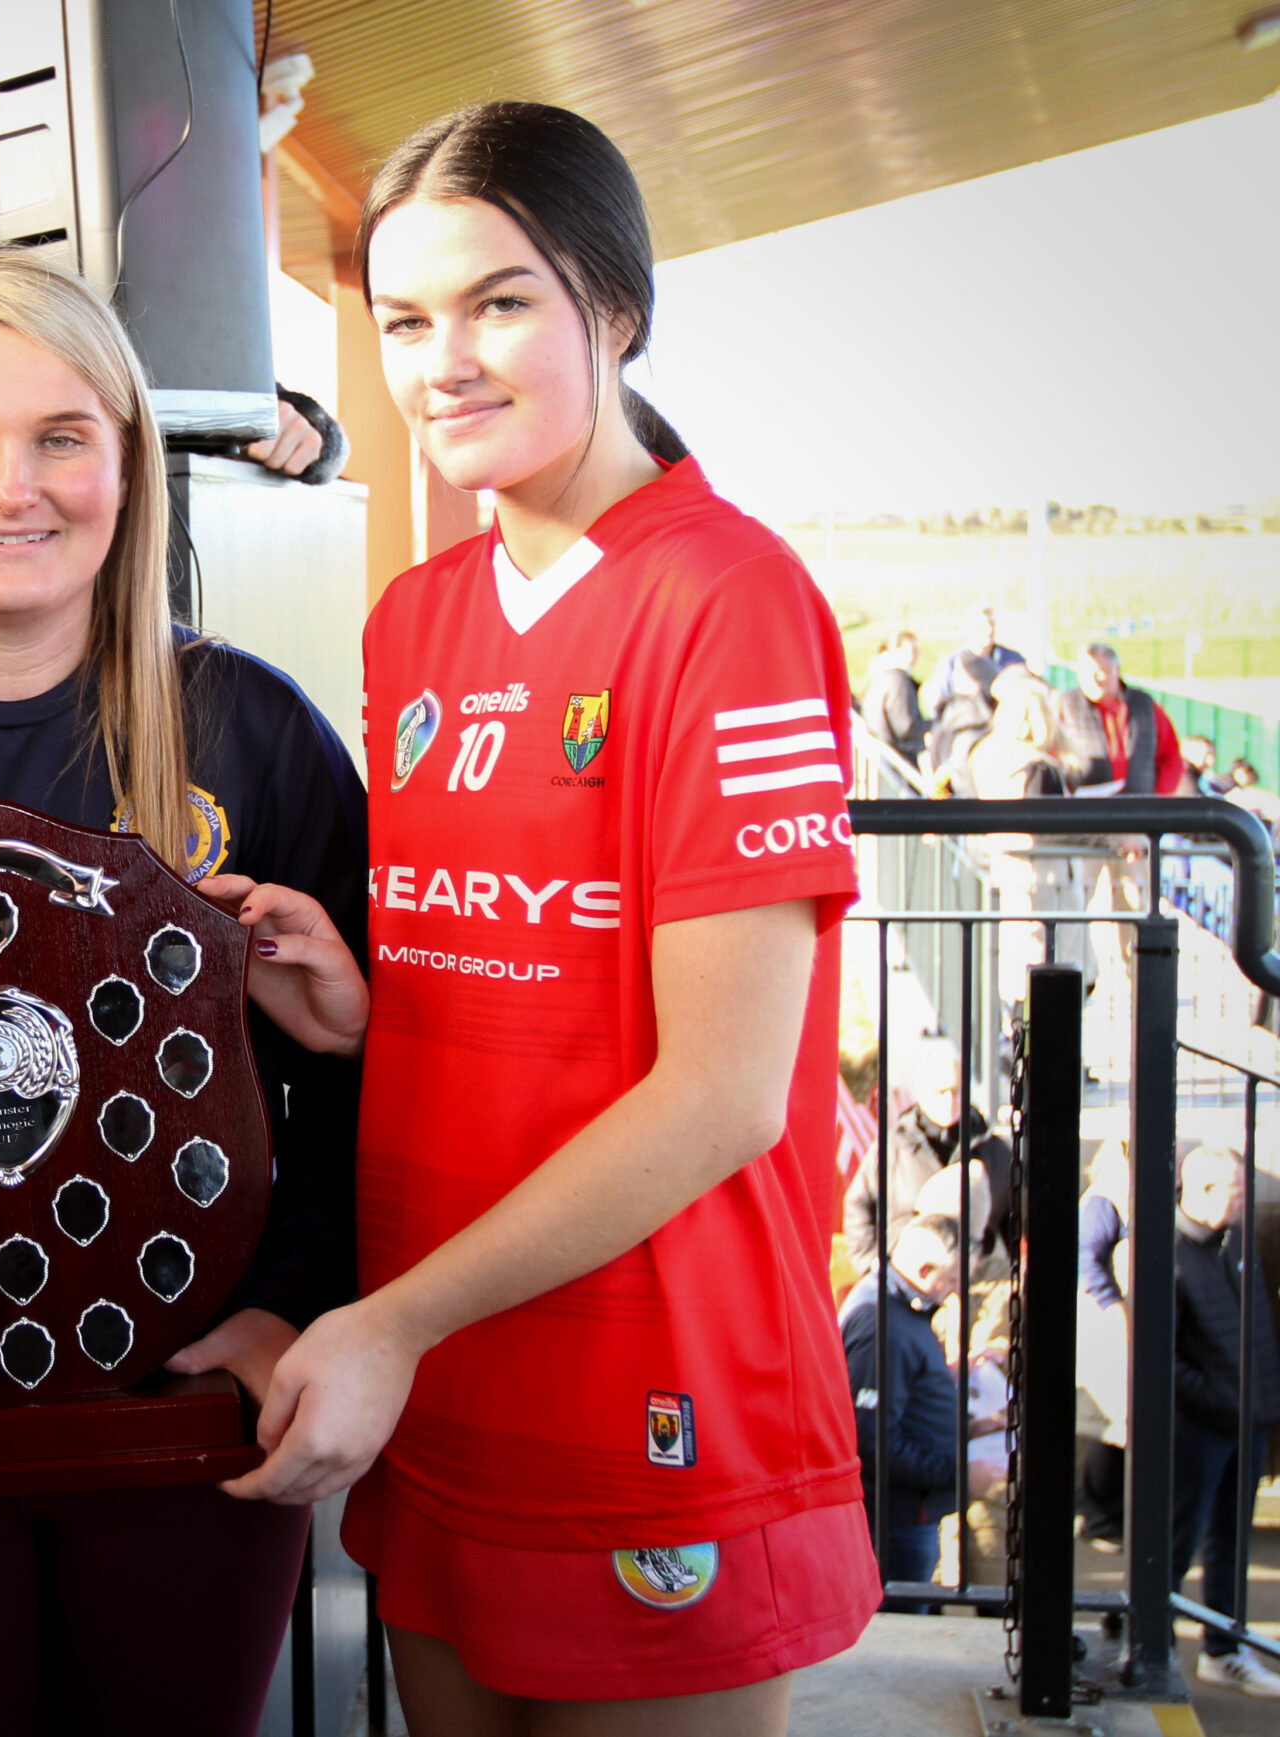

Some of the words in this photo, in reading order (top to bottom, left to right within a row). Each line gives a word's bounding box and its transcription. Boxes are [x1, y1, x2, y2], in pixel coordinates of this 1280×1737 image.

[447, 720, 506, 791] 10
[551, 776, 605, 788] CORCAIGH
[736, 812, 852, 858] CORC
